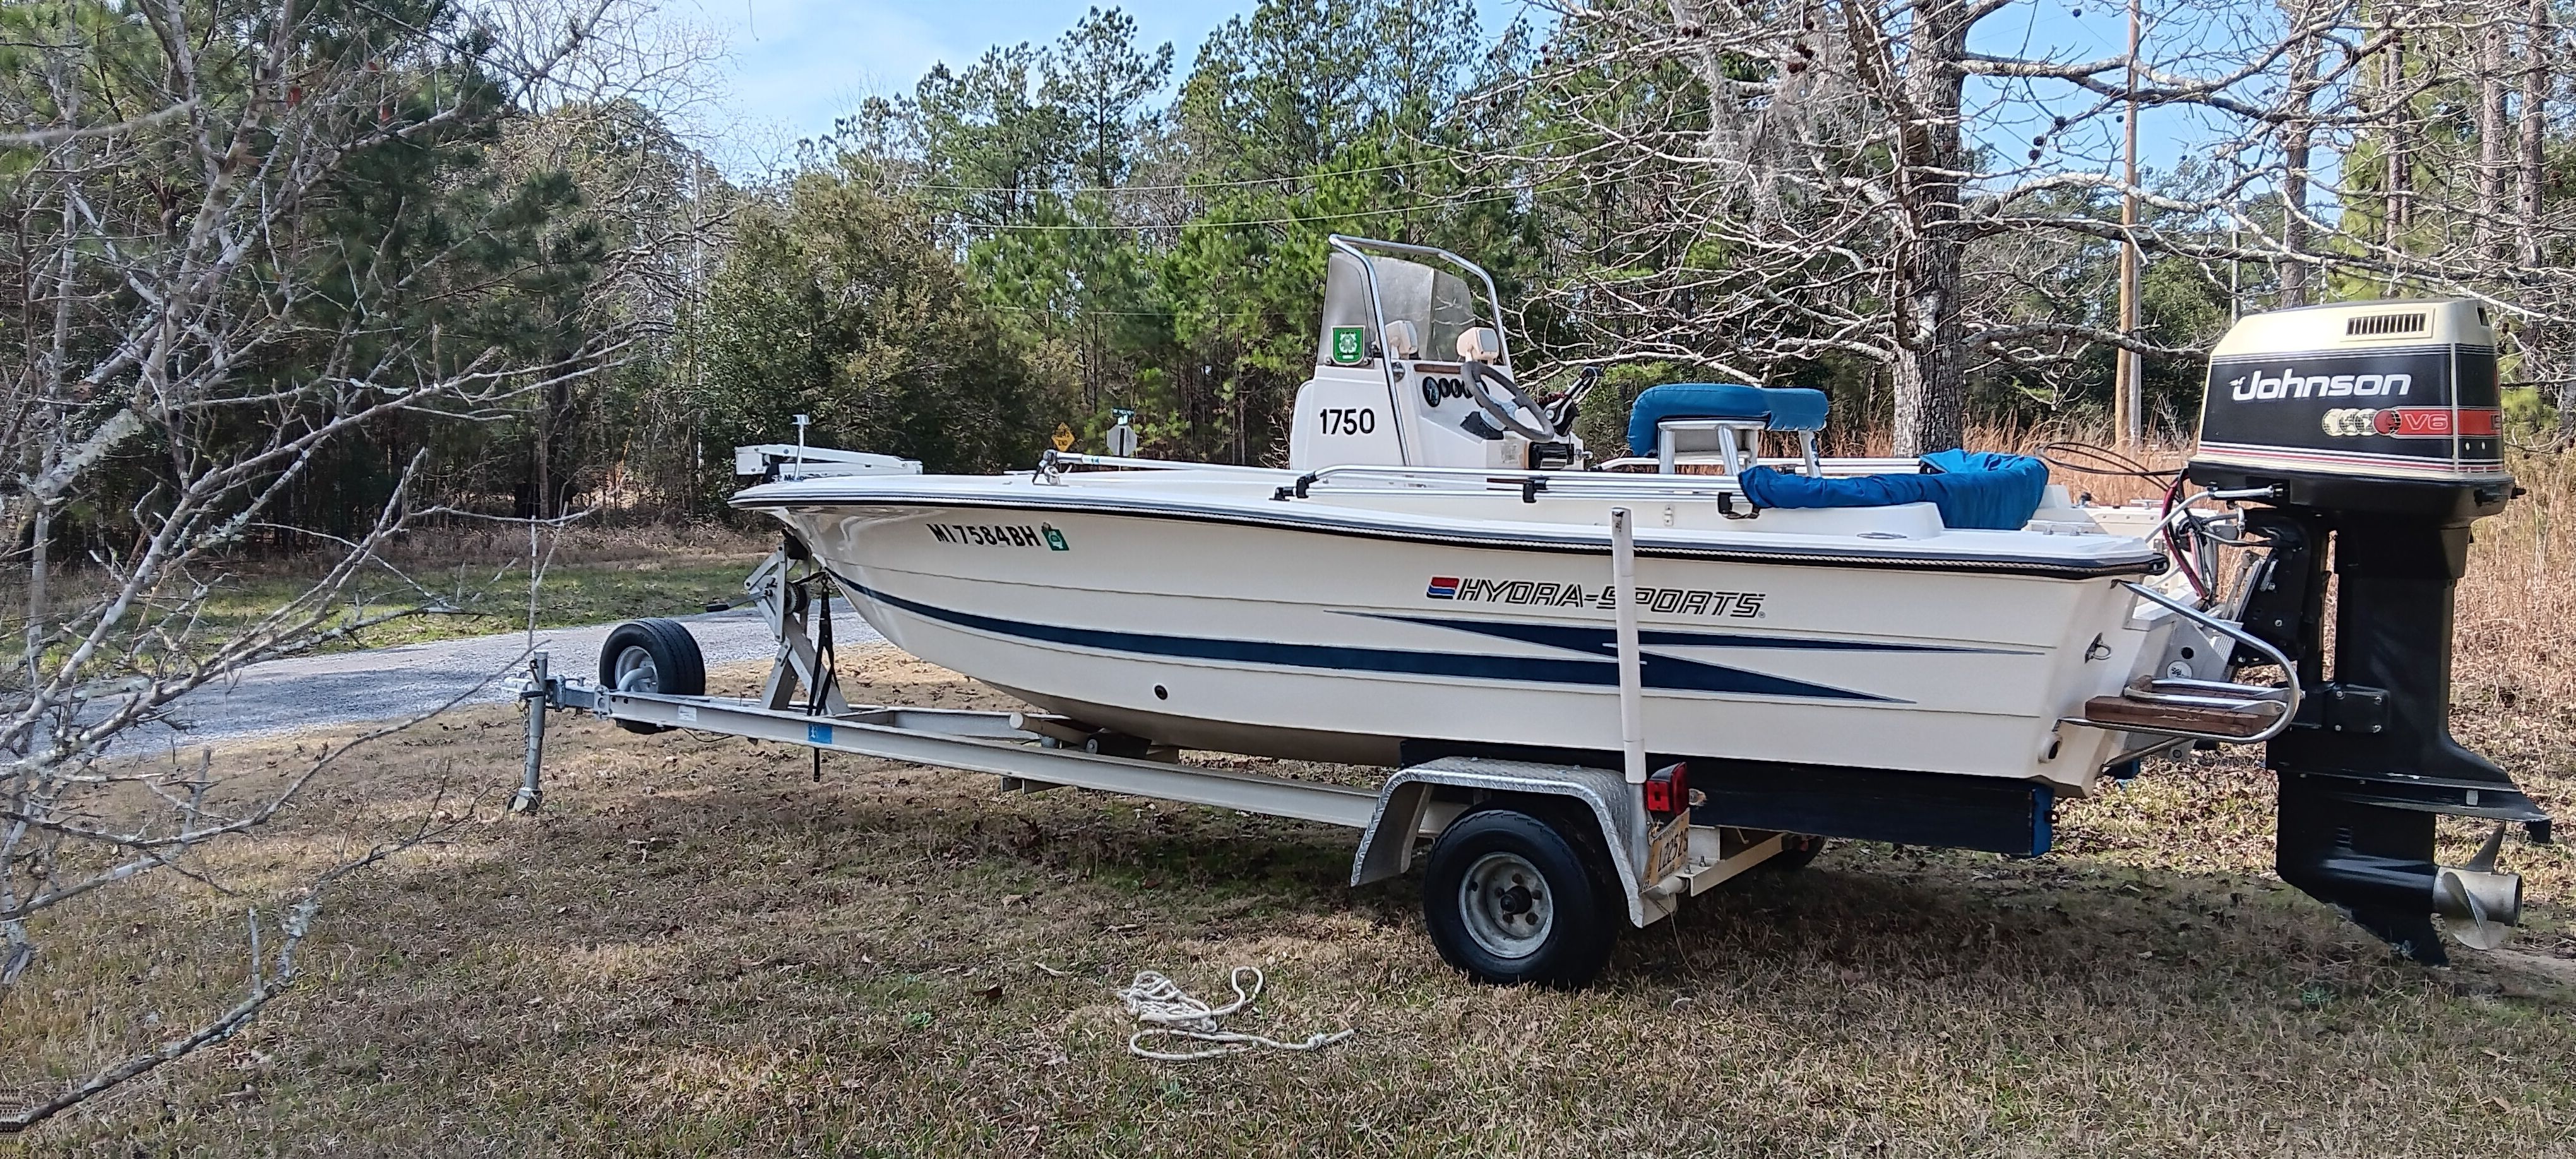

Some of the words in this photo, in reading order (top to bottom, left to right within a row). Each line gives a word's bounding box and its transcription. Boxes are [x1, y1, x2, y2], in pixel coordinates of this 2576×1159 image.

[2231, 368, 2412, 401] Johnson
[1320, 408, 1375, 436] 1750
[2404, 413, 2448, 431] V6
